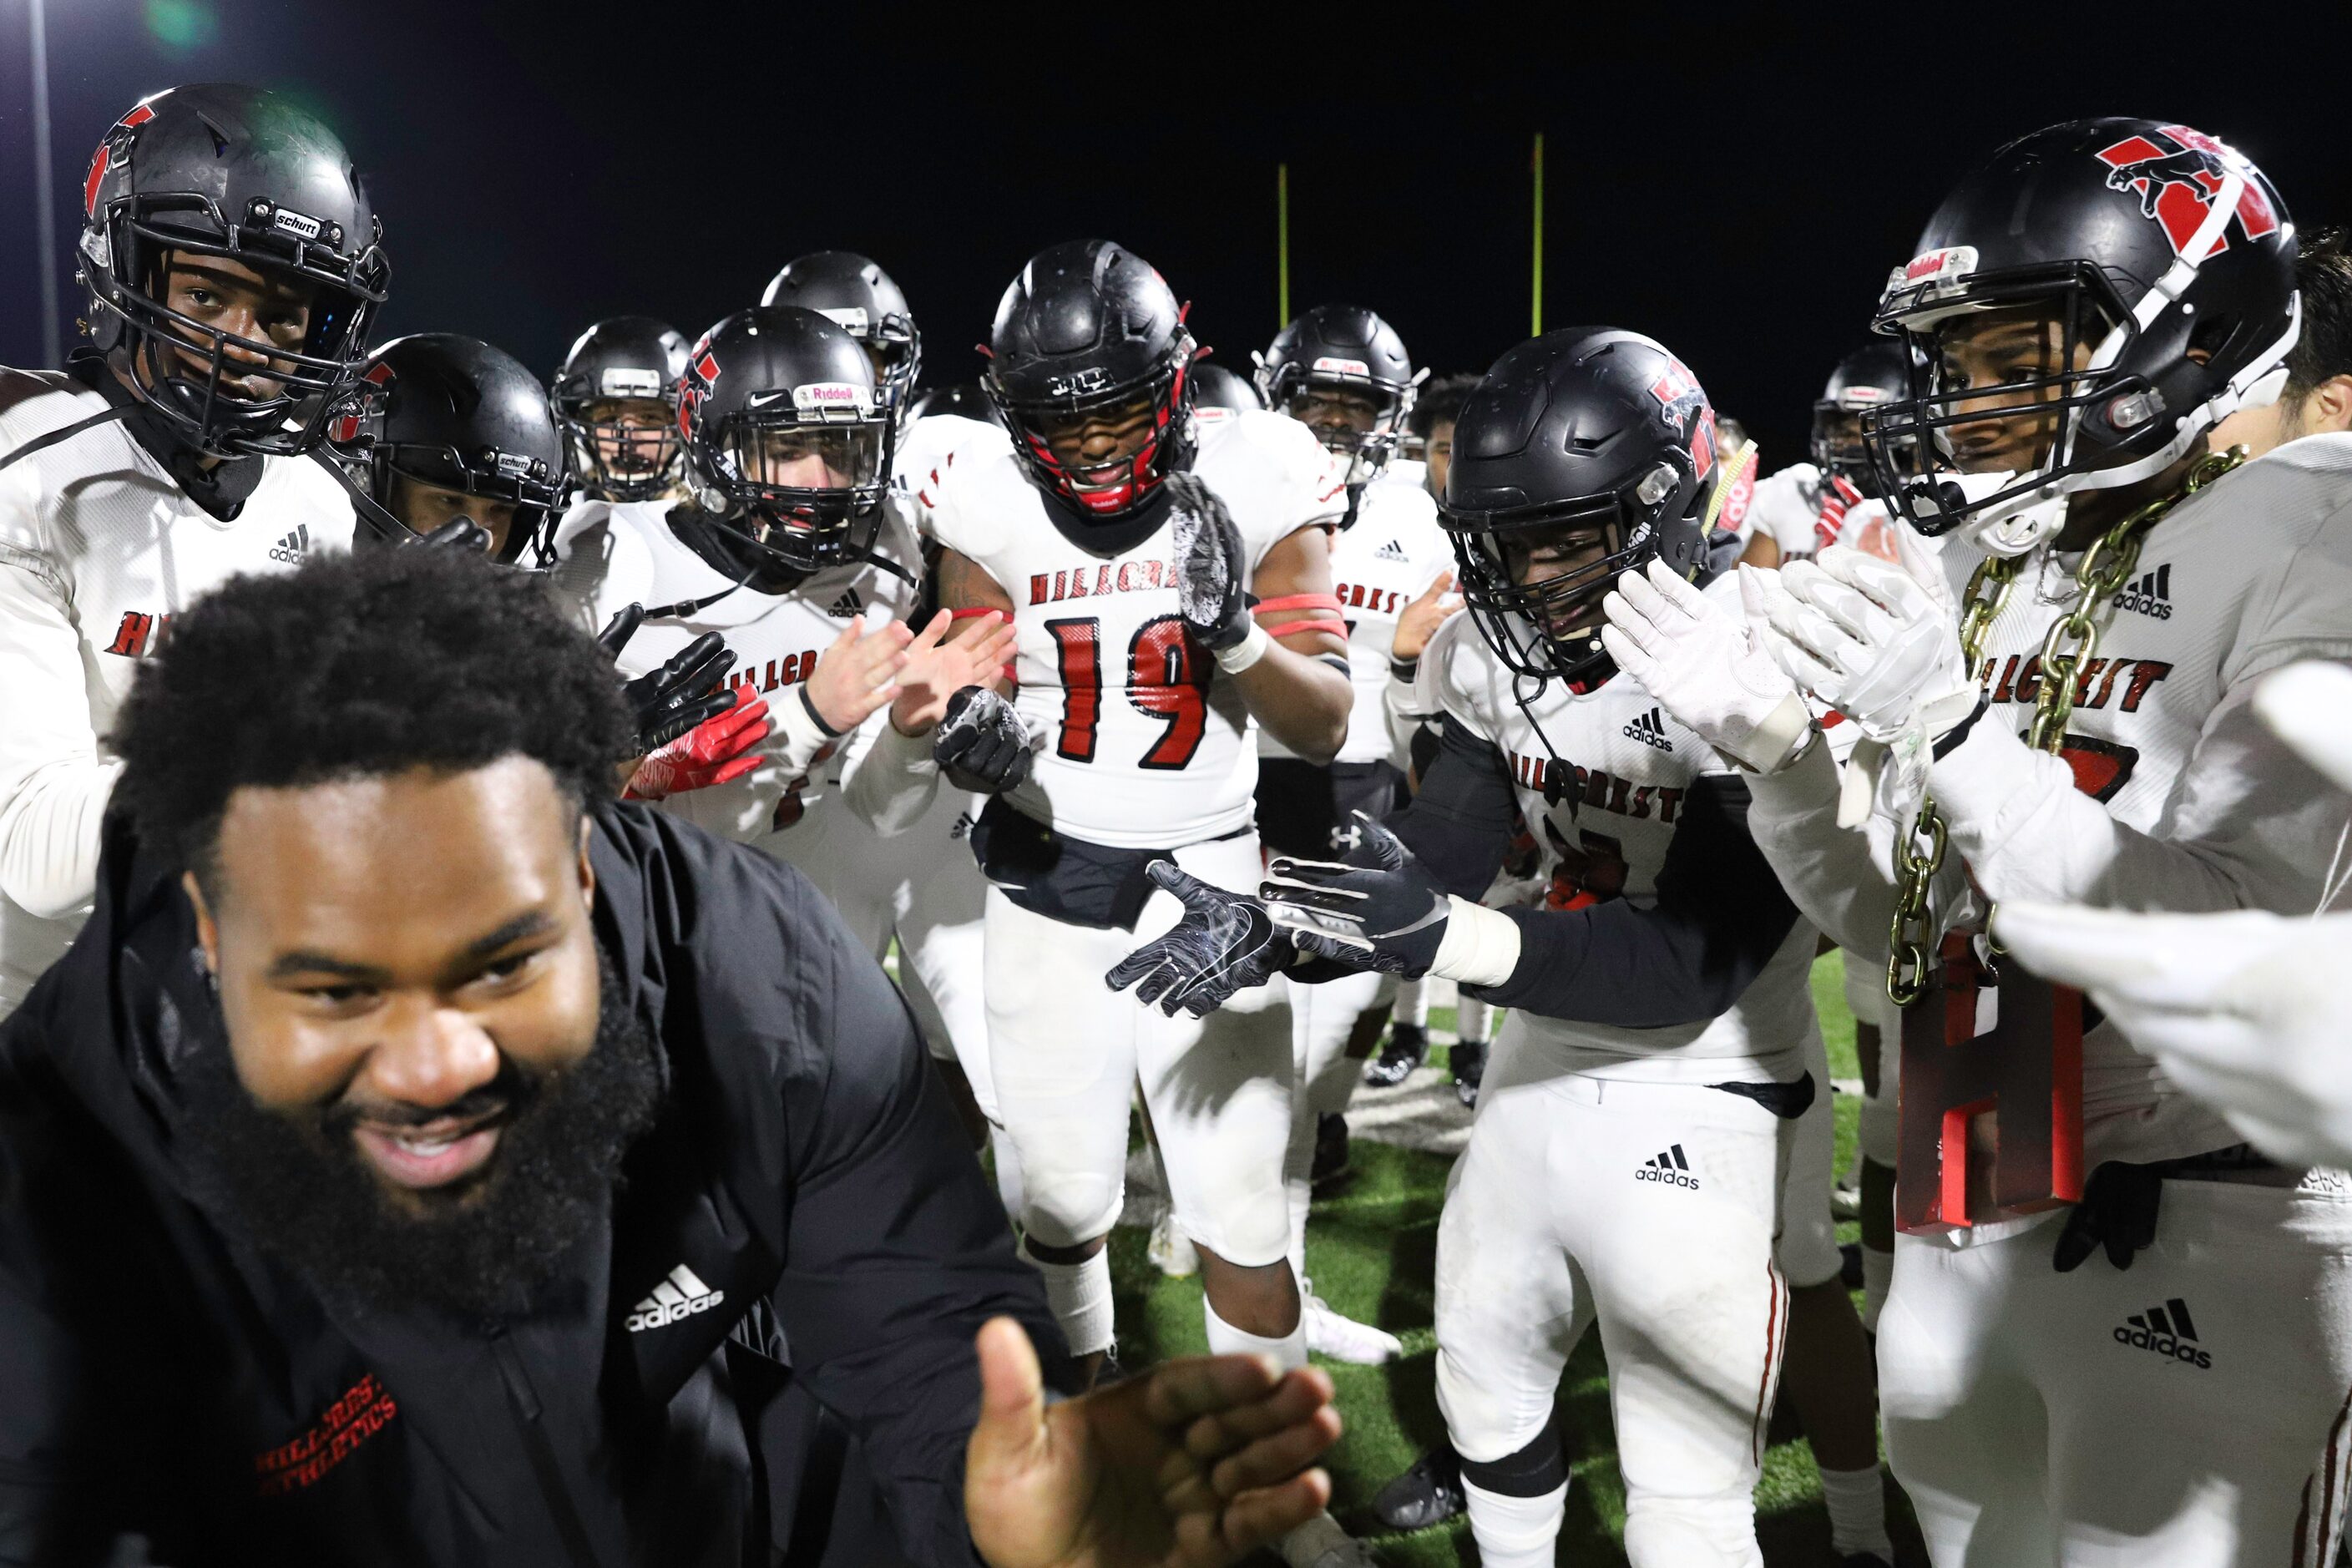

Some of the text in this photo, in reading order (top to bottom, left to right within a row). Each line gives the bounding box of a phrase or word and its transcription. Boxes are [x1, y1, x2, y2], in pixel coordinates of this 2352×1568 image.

[276, 215, 316, 235] schutt
[813, 387, 852, 400] Riddell
[499, 458, 529, 469] schutt
[1029, 560, 1178, 605] HILLCR
[2112, 591, 2172, 620] adidas
[1044, 614, 1210, 771] 19
[1623, 725, 1673, 752] adidas
[1635, 1167, 1700, 1191] adidas
[625, 1290, 725, 1333] adidas
[2112, 1327, 2212, 1370] adidas
